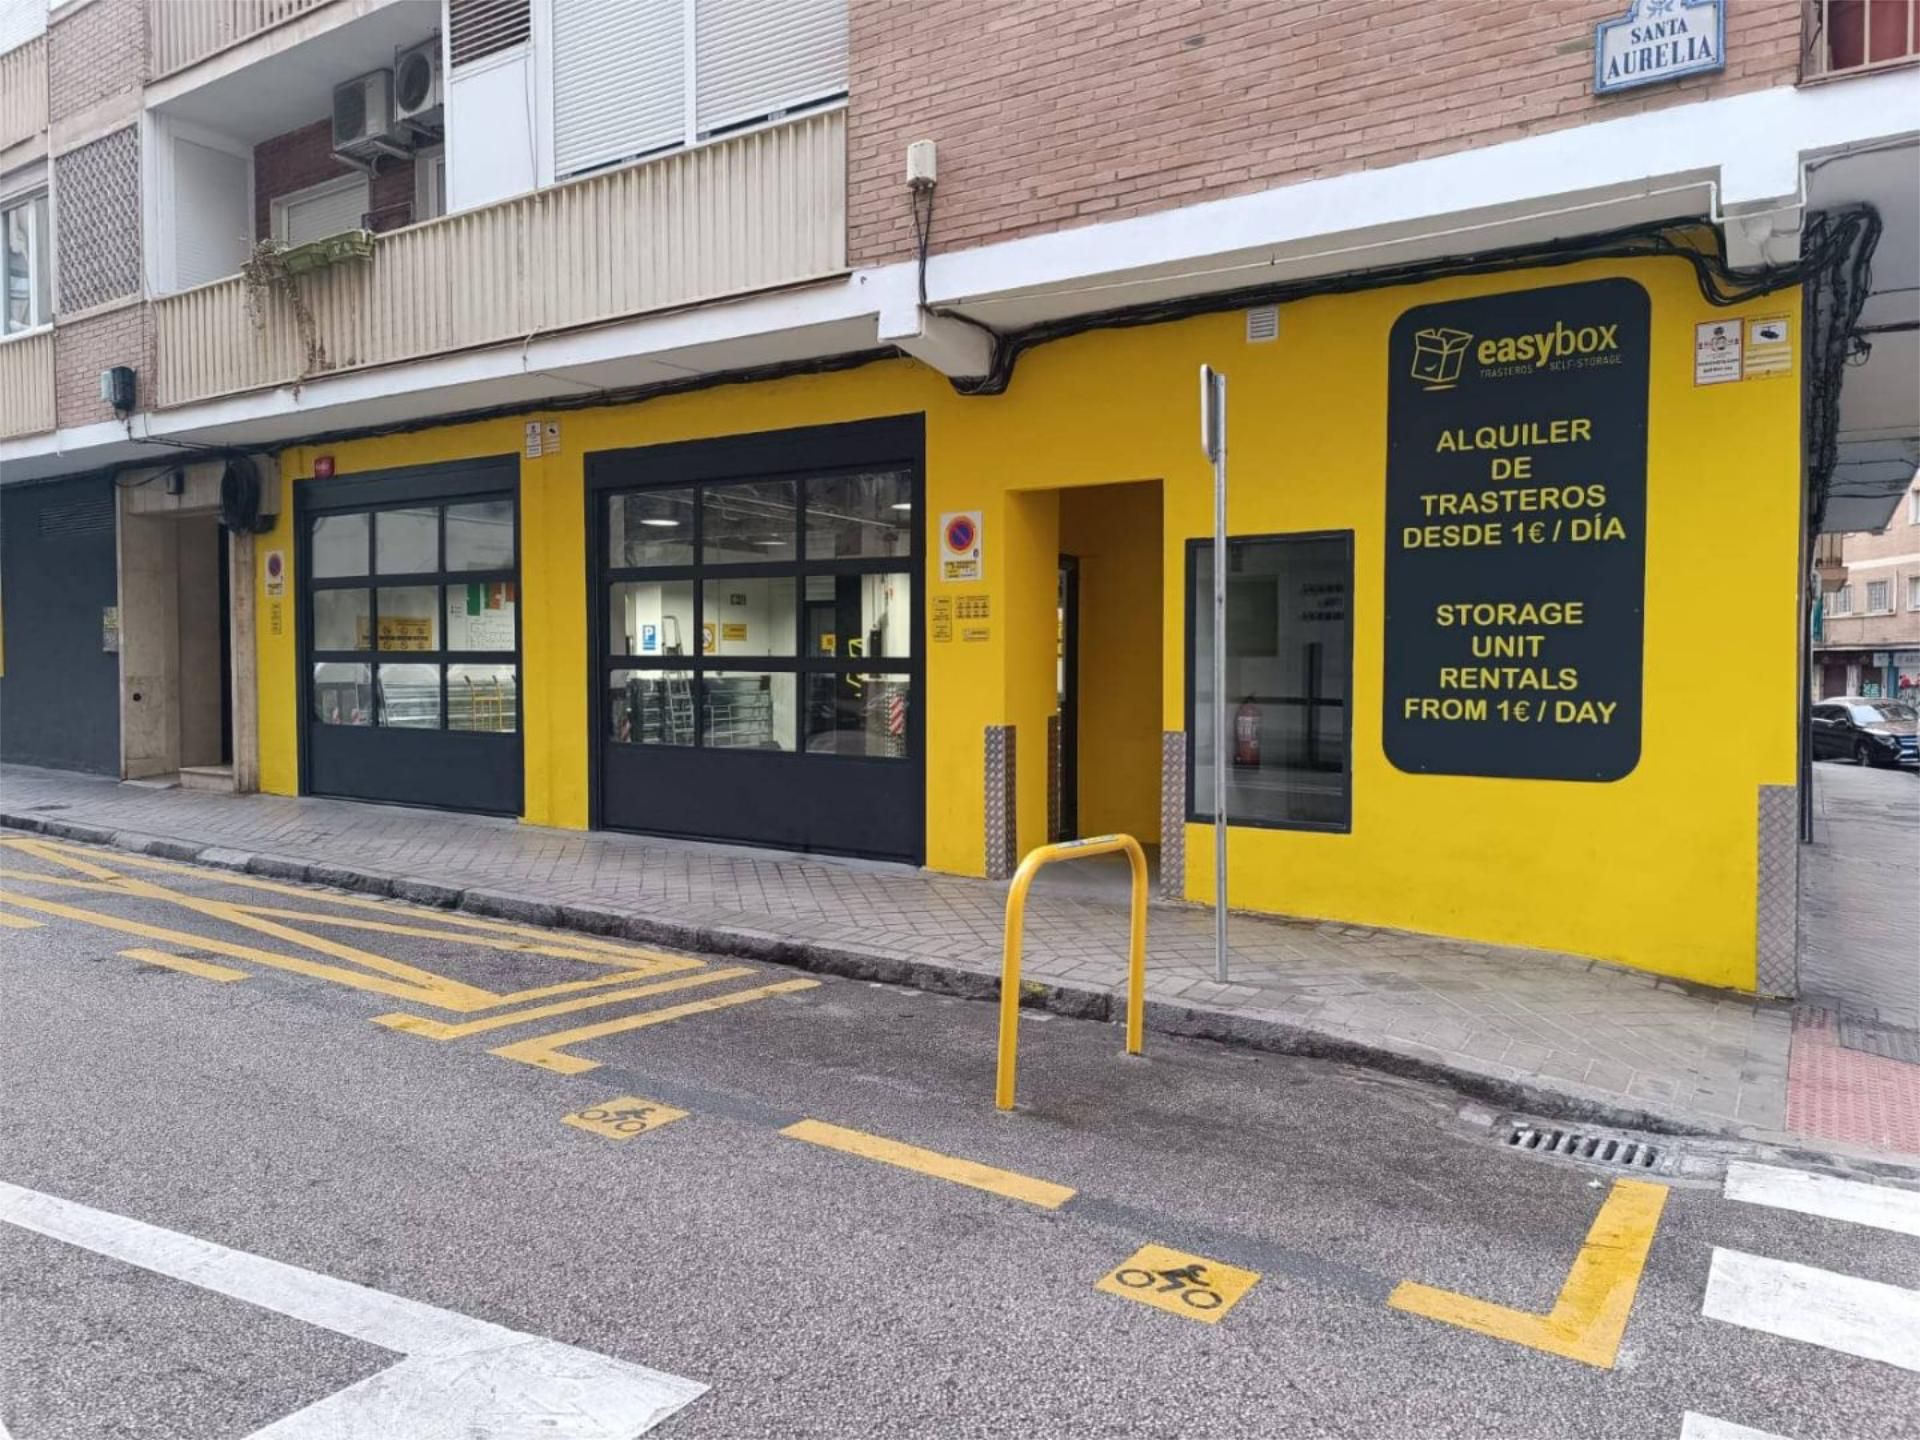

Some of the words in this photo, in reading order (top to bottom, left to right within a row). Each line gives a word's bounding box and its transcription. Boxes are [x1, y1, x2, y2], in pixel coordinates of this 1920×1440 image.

[1632, 17, 1688, 45] SANTA
[1607, 34, 1713, 79] AURELIA
[1478, 320, 1619, 368] easybox
[1480, 365, 1533, 379] TRASTEROS
[1436, 418, 1592, 452] ALQUILER
[1491, 456, 1532, 480] DE
[1421, 484, 1606, 517] TRASTEROS
[1403, 523, 1502, 549] DESDE
[1511, 521, 1546, 545] 1€
[1552, 519, 1562, 542] /
[1571, 513, 1627, 542] DÍA
[1436, 602, 1584, 626] STORAGE
[1472, 635, 1545, 658] UNIT
[1440, 667, 1579, 691] RENTALS
[1404, 698, 1488, 721] FROM
[1496, 700, 1530, 722] 1€
[1537, 700, 1547, 723] /
[1555, 701, 1617, 724] DAY
